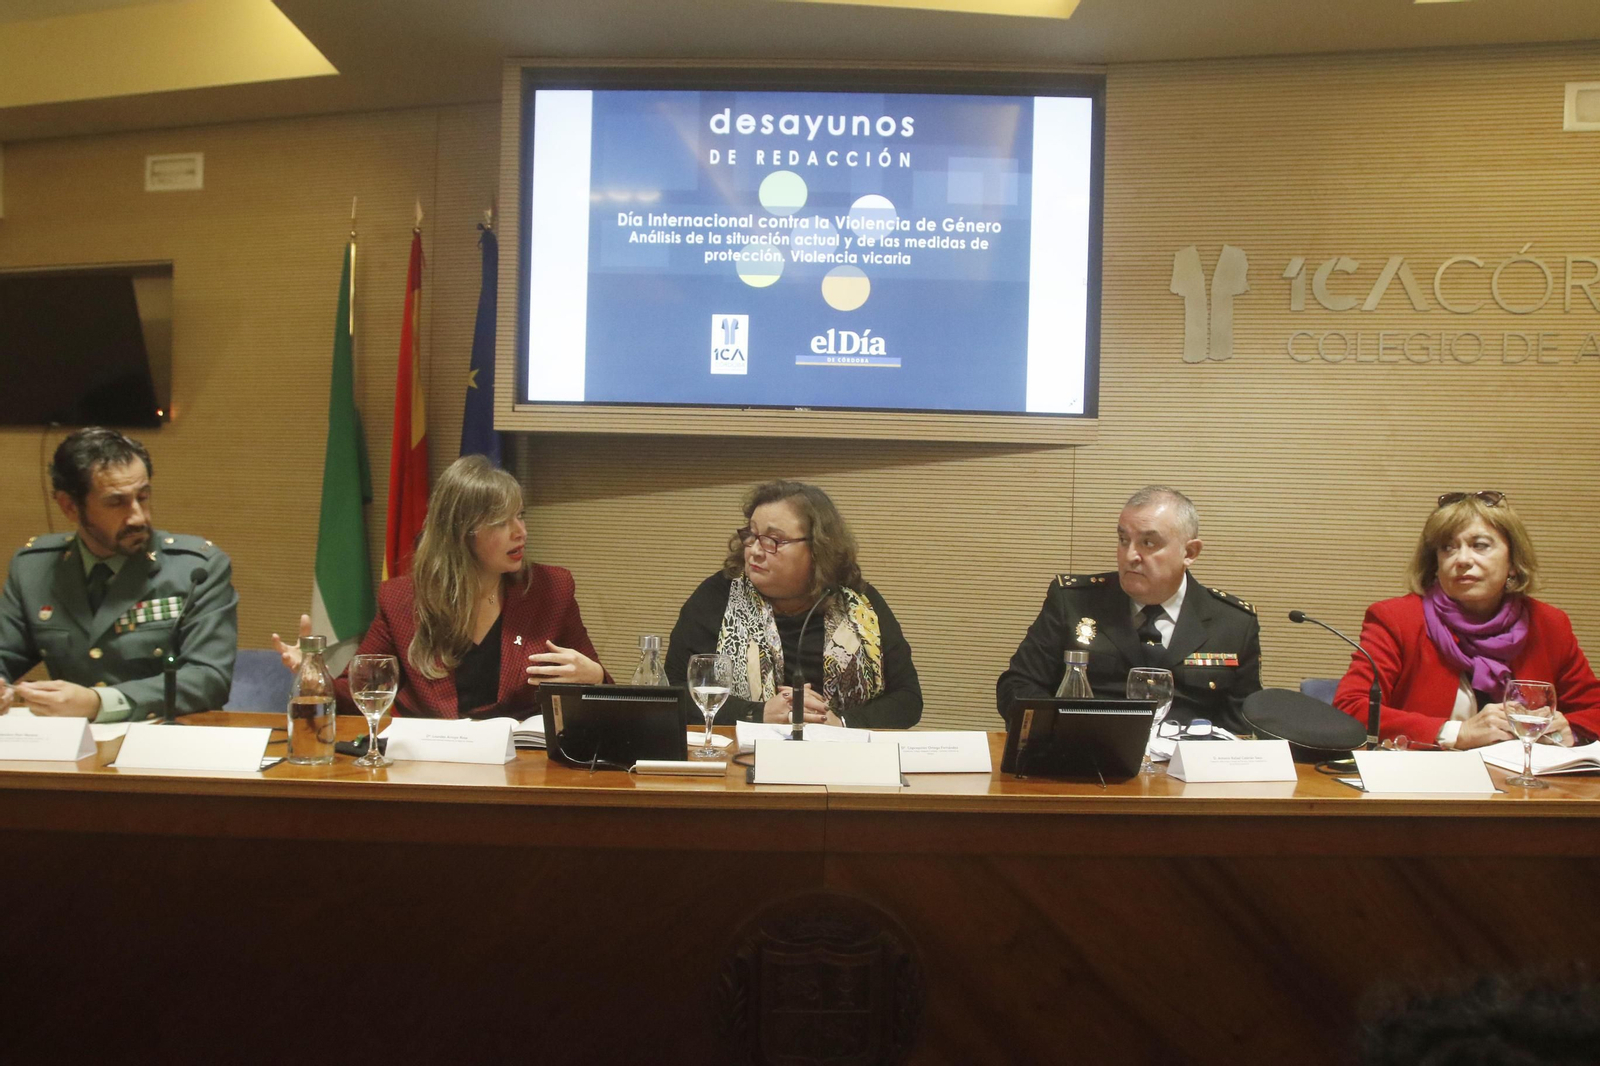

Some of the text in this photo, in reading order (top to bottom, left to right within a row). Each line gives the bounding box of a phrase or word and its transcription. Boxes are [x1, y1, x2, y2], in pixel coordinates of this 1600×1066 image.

[709, 108, 915, 141] desayunos
[709, 147, 911, 167] DE REDACCIÓN
[617, 211, 1002, 233] Día Internacional contra la Violencia de Género
[628, 229, 989, 250] Análisis de la situación actual y de las medidas de
[704, 248, 912, 265] protección. Violencia vicaria
[1286, 331, 1485, 364] COLEGIO
[1502, 332, 1560, 364] DE
